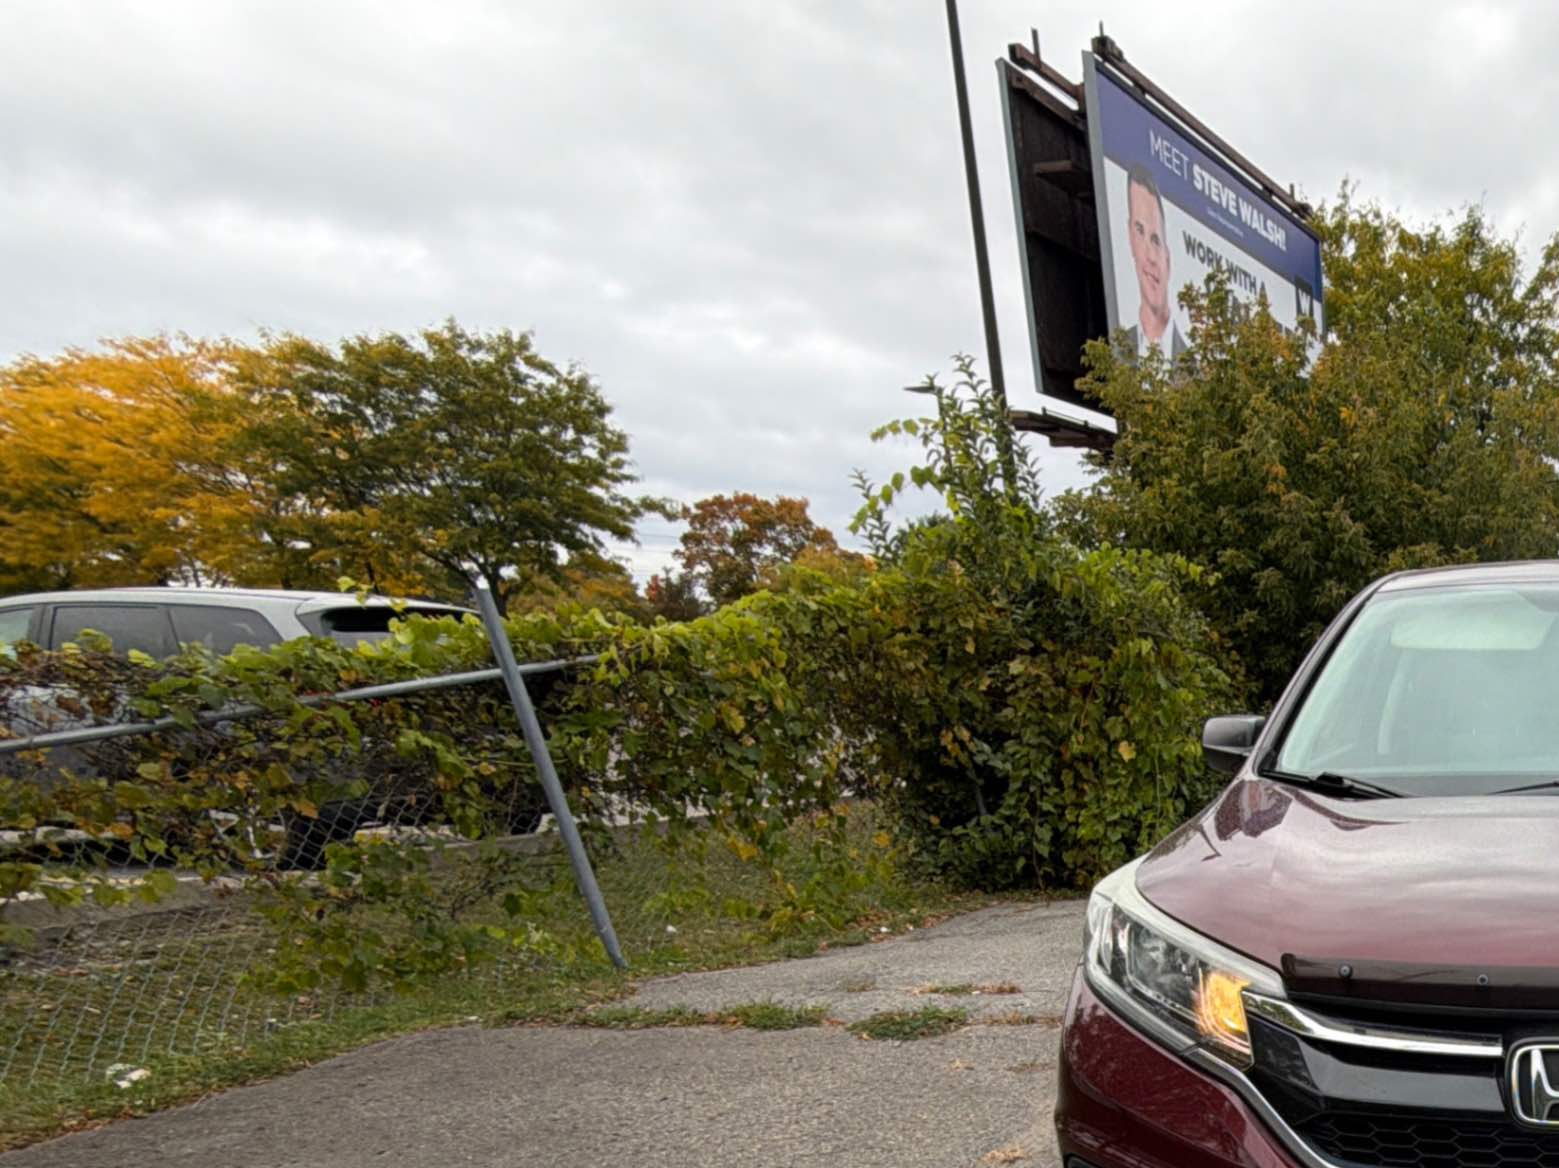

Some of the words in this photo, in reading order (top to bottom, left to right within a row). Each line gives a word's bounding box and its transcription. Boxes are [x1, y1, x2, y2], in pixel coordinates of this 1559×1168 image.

[1150, 130, 1188, 180] MEET
[1192, 163, 1237, 217] STEVE
[1239, 197, 1286, 252] WALSH!
